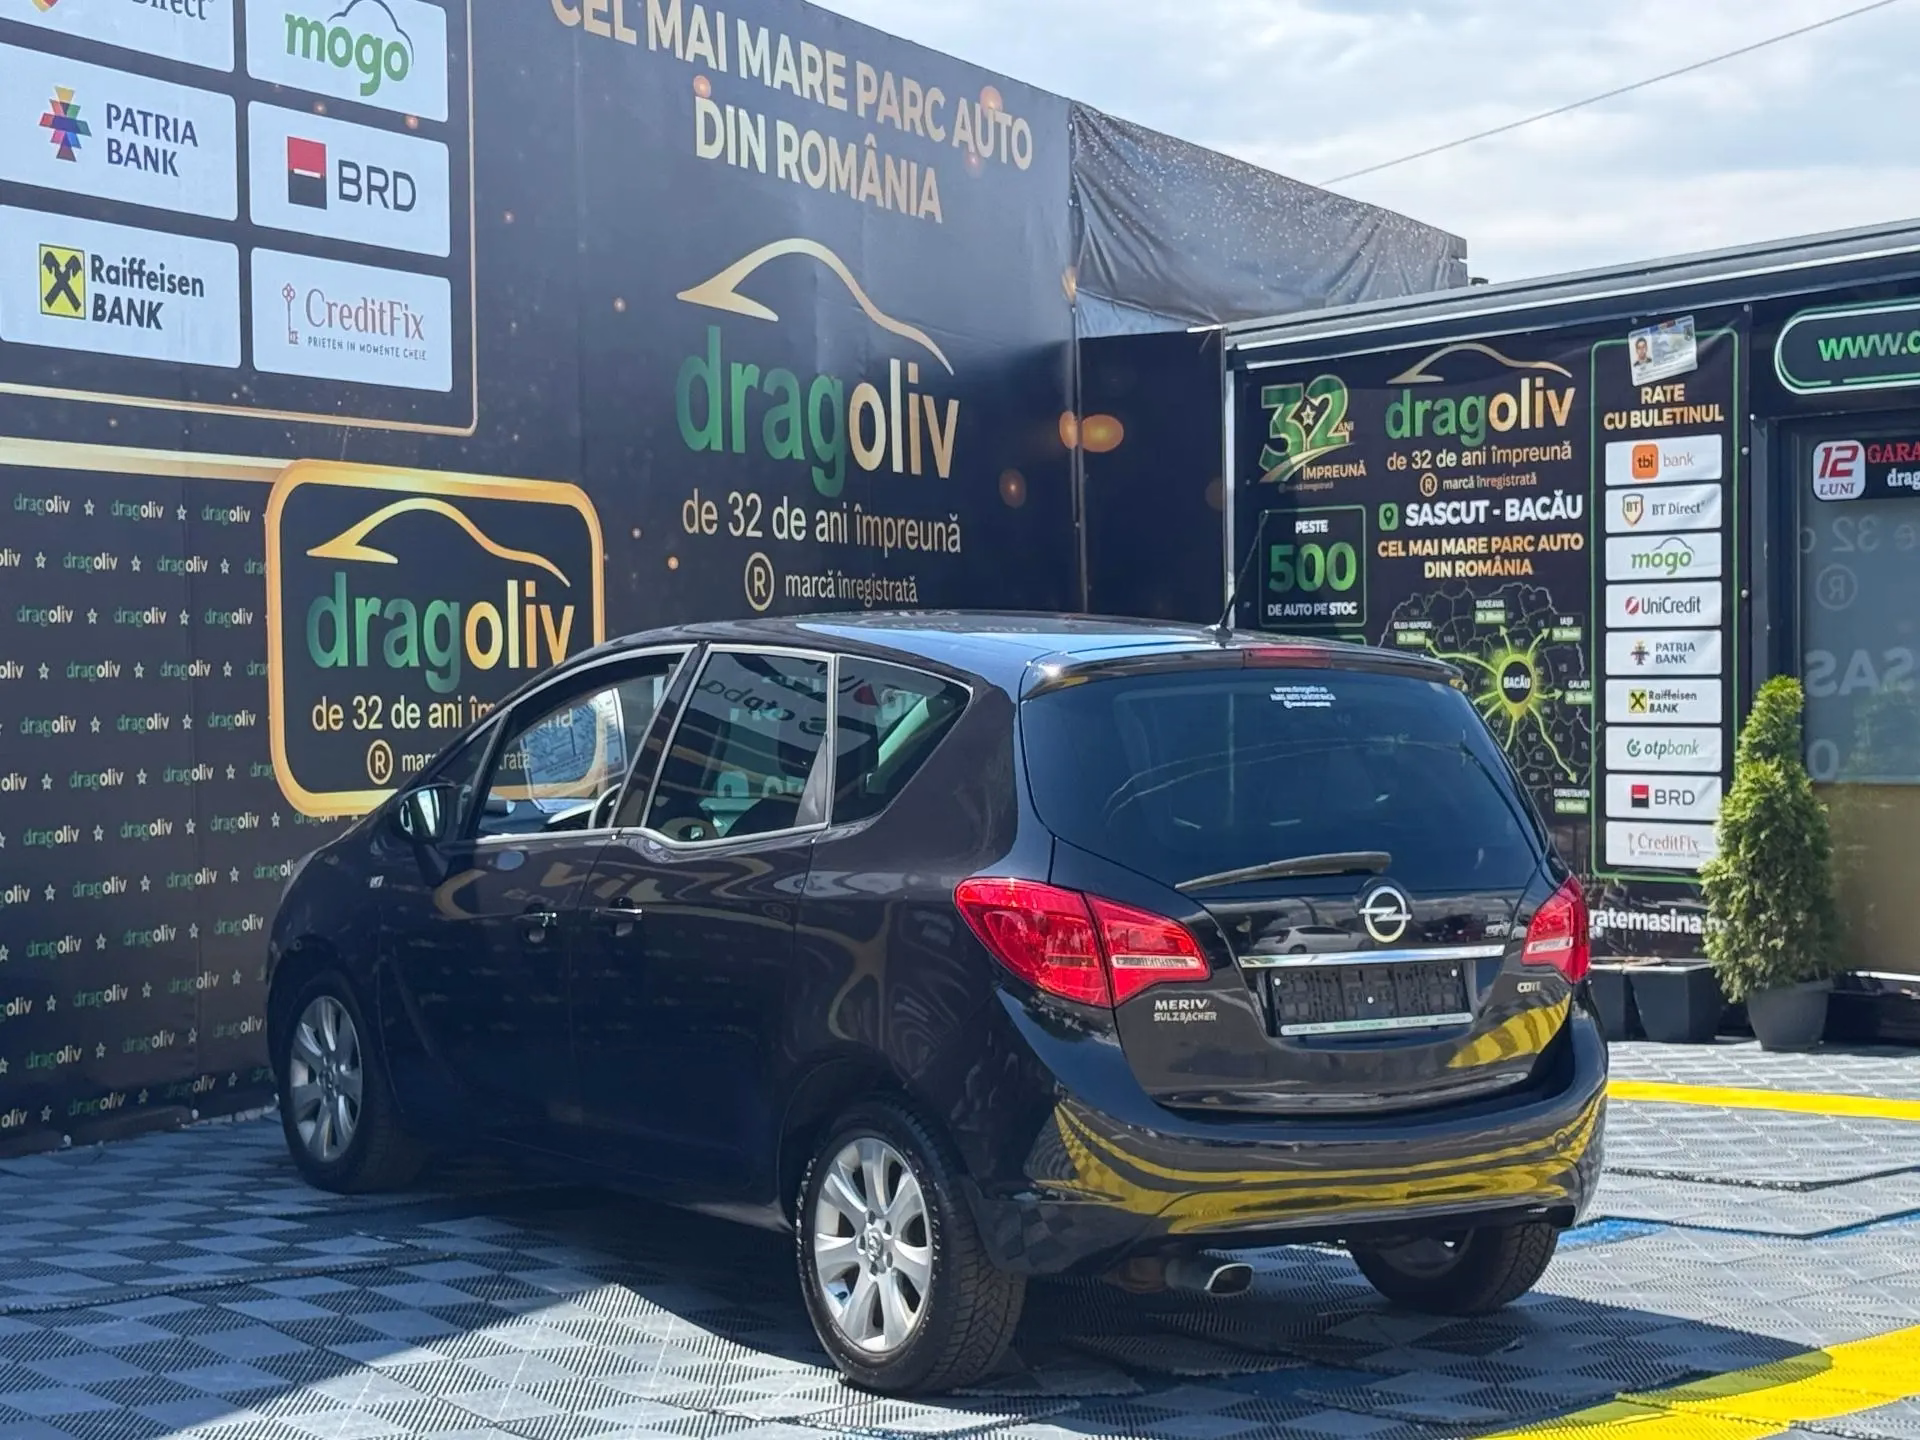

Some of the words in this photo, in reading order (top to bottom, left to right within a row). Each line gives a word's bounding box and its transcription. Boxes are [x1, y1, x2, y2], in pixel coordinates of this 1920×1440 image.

[284, 13, 409, 97] mogo
[646, 0, 727, 73] MAI
[737, 19, 848, 109] MARE
[856, 60, 947, 143] PARC
[952, 97, 1033, 171] AUTO
[106, 103, 198, 147] PATRIA
[107, 138, 179, 177] BANK
[694, 96, 766, 174] DIN
[776, 120, 942, 224] ROMÂNIA
[338, 159, 417, 212] BRD
[91, 254, 205, 298] Raiffeisen
[92, 293, 163, 330] BANK
[306, 288, 424, 341] CreditFix
[307, 336, 343, 350] PRIETEN
[360, 343, 400, 358] MOMENTE
[1641, 383, 1685, 404] RATE
[675, 325, 960, 497] dragoliv
[1259, 374, 1348, 472] 32
[1385, 376, 1576, 447] dragoliv
[1603, 412, 1627, 430] CU
[1630, 404, 1724, 428] BULETINUL
[1387, 452, 1407, 471] de
[1411, 450, 1432, 469] 32
[1436, 448, 1457, 467] de
[1461, 446, 1486, 467] ani
[1491, 440, 1572, 467] împreună
[1637, 454, 1653, 468] tbi
[1663, 452, 1695, 467] bank
[1819, 445, 1859, 479] 12
[1443, 475, 1475, 491] marcă
[1476, 472, 1537, 490] înregistrată
[1820, 482, 1855, 496] LUNI
[14, 493, 70, 516] dragoliv
[111, 500, 163, 521] dragoliv
[202, 504, 250, 525] dragoliv
[1405, 500, 1490, 527] SASCUT
[1505, 489, 1584, 523] BACĂU
[1652, 503, 1666, 516] BT
[1668, 502, 1701, 516] Direct
[682, 488, 718, 535] de
[728, 491, 763, 538] 32
[772, 496, 807, 541] de
[815, 502, 848, 544] ani
[854, 503, 961, 558] împreună
[1295, 520, 1329, 534] PESTE
[1377, 541, 1407, 557] CEL
[1409, 538, 1438, 557] MAI
[1441, 537, 1489, 556] MARE
[1491, 535, 1535, 554] PARC
[1537, 533, 1584, 552] AUTO
[63, 552, 117, 574] dragoliv
[157, 556, 208, 576] dragoliv
[1269, 542, 1357, 592] 500
[1424, 561, 1452, 579] DIN
[1455, 556, 1533, 578] ROMÂNIA
[1631, 551, 1692, 575] mogo
[785, 570, 835, 599] marcă
[837, 571, 918, 608] înregistrată
[16, 605, 73, 627] dragoliv
[114, 606, 167, 627] dragoliv
[205, 607, 253, 628] dragoliv
[1267, 604, 1282, 616] DE
[1284, 603, 1312, 616] AUTO
[1314, 603, 1328, 615] PE
[1329, 602, 1357, 615] STOC
[1642, 596, 1701, 615] UniCredit
[306, 571, 575, 694] dragoliv
[1655, 654, 1686, 664] BANK
[1656, 642, 1696, 653] PATRIA
[66, 661, 121, 682] dragoliv
[160, 660, 211, 680] dragoliv
[1648, 688, 1698, 701] Raiffeisen
[312, 696, 344, 732] de
[352, 695, 383, 730] 32
[391, 695, 421, 729] de
[428, 697, 463, 729] ani
[1649, 703, 1679, 714] BANK
[20, 715, 77, 738] dragoliv
[117, 713, 170, 734] dragoliv
[208, 710, 256, 731] dragoliv
[1644, 739, 1699, 760] otpbank
[69, 768, 124, 791] dragoliv
[163, 764, 214, 786] dragoliv
[1654, 789, 1695, 806] BRD
[23, 824, 80, 848] dragoliv
[120, 818, 173, 841] dragoliv
[210, 812, 260, 834] dragoliv
[1638, 833, 1699, 852] CreditFix
[72, 876, 127, 900] dragoliv
[166, 867, 218, 890] dragoliv
[1589, 907, 1718, 935] ratemasina.
[26, 936, 82, 957] dragoliv
[123, 925, 176, 947] dragoliv
[213, 914, 264, 936] dragoliv
[73, 984, 128, 1008] dragoliv
[1155, 999, 1210, 1010] MERIV
[26, 1045, 82, 1070] dragoliv
